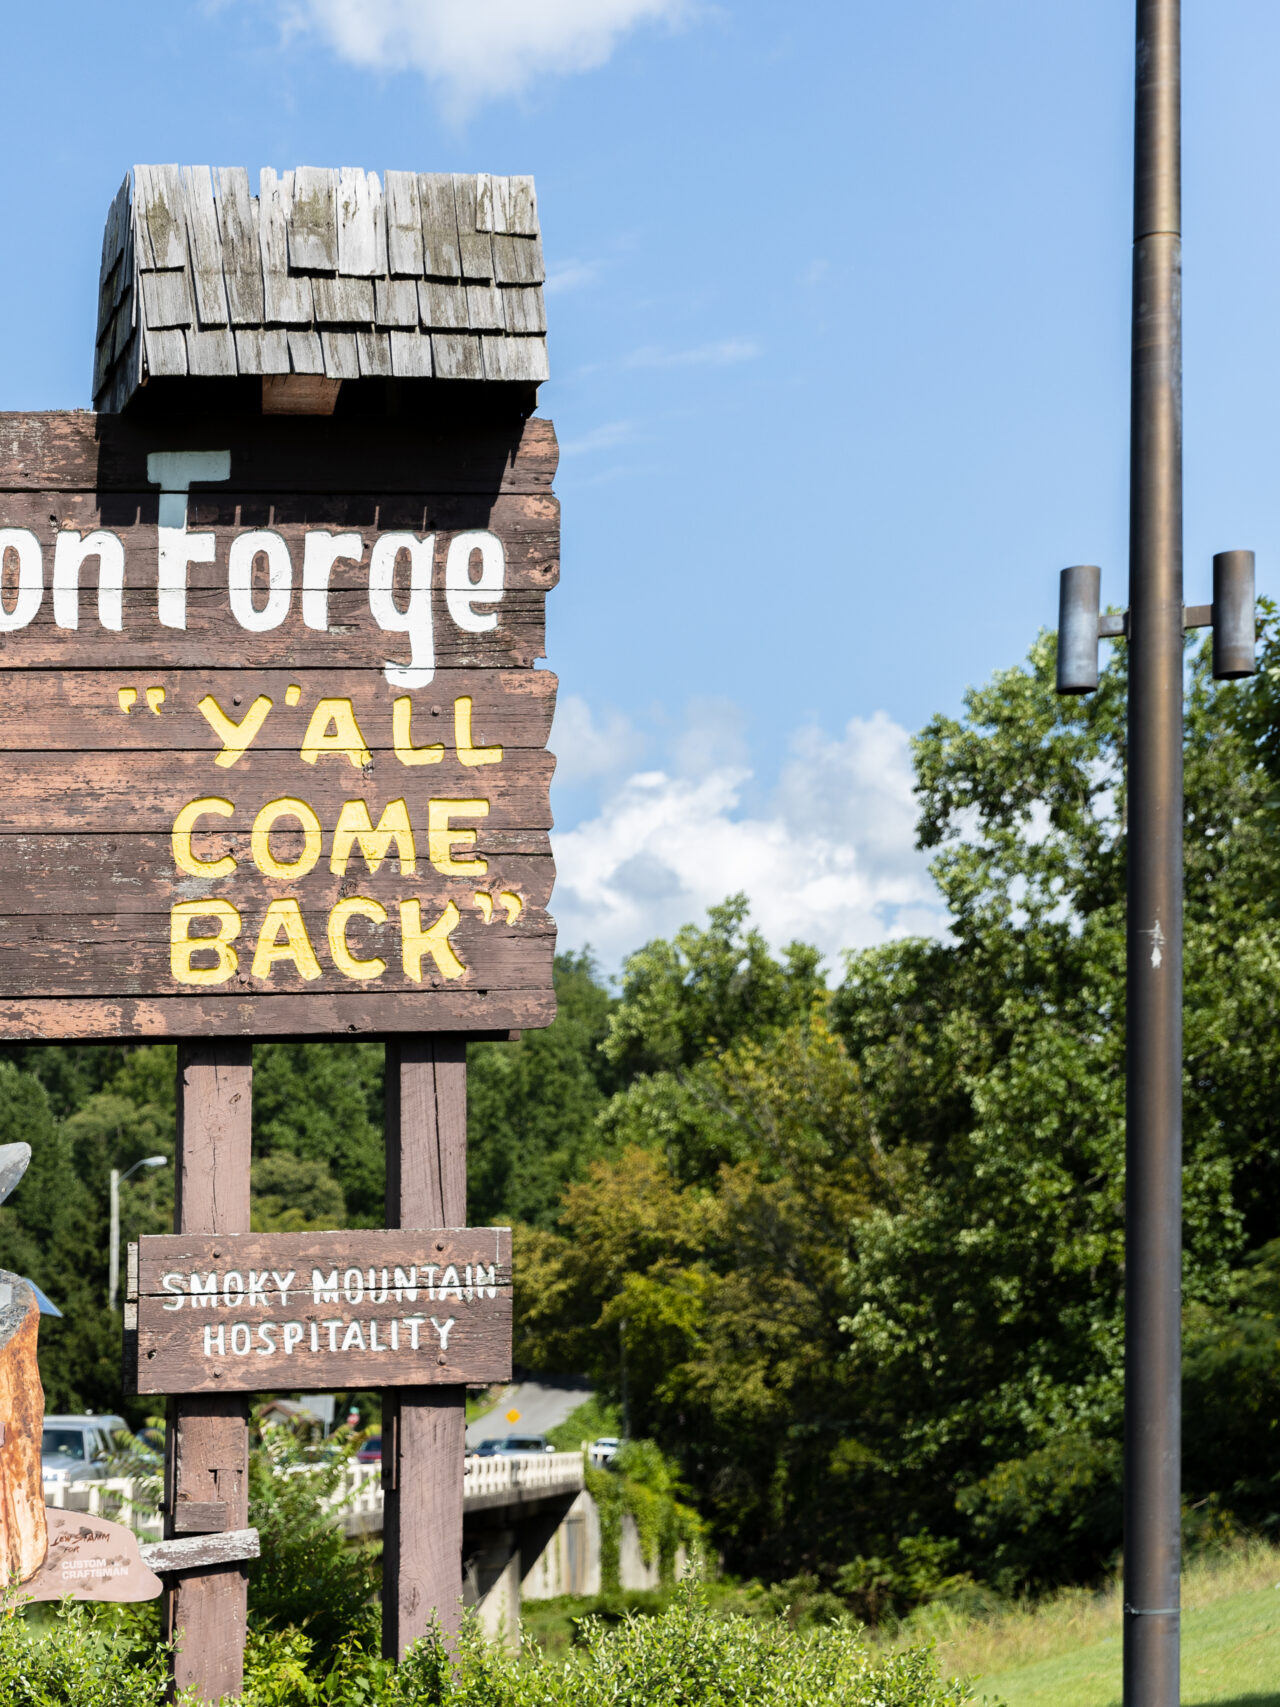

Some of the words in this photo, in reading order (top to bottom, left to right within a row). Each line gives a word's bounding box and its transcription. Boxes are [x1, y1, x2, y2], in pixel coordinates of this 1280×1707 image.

[147, 450, 505, 689] Forge
[171, 797, 490, 879] COME
[162, 1270, 296, 1311] SMOKY
[312, 1263, 498, 1305] MOUNTAIN
[203, 1316, 456, 1357] HOSPITALITY
[62, 1559, 107, 1569] CUSTOM
[62, 1567, 129, 1580] CRAFTSMAN
